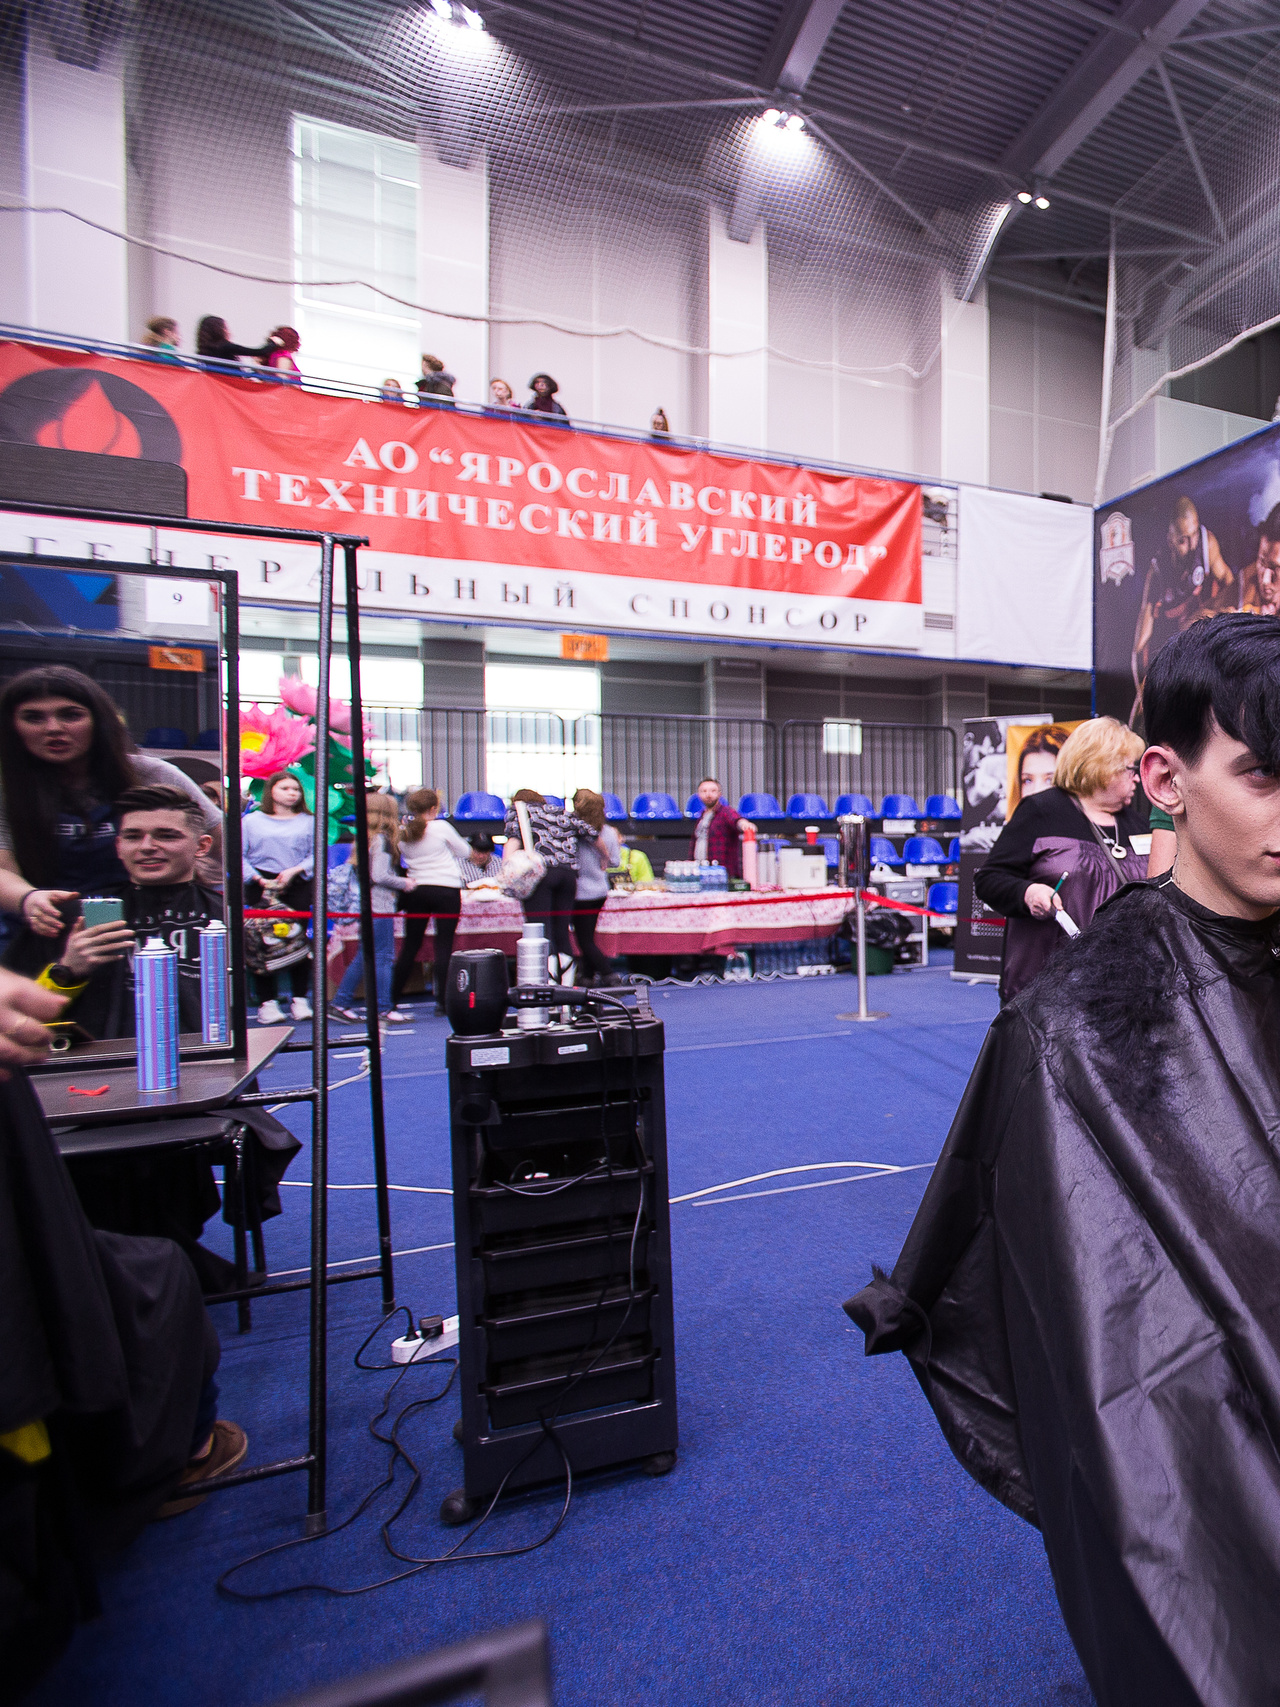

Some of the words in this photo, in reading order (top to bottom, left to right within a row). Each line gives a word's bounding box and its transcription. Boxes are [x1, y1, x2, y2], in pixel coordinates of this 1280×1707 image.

[343, 437, 418, 474] АО
[232, 467, 659, 548] ТЕХНИЧЕСКИЙ
[631, 593, 868, 632] СПОНСОР
